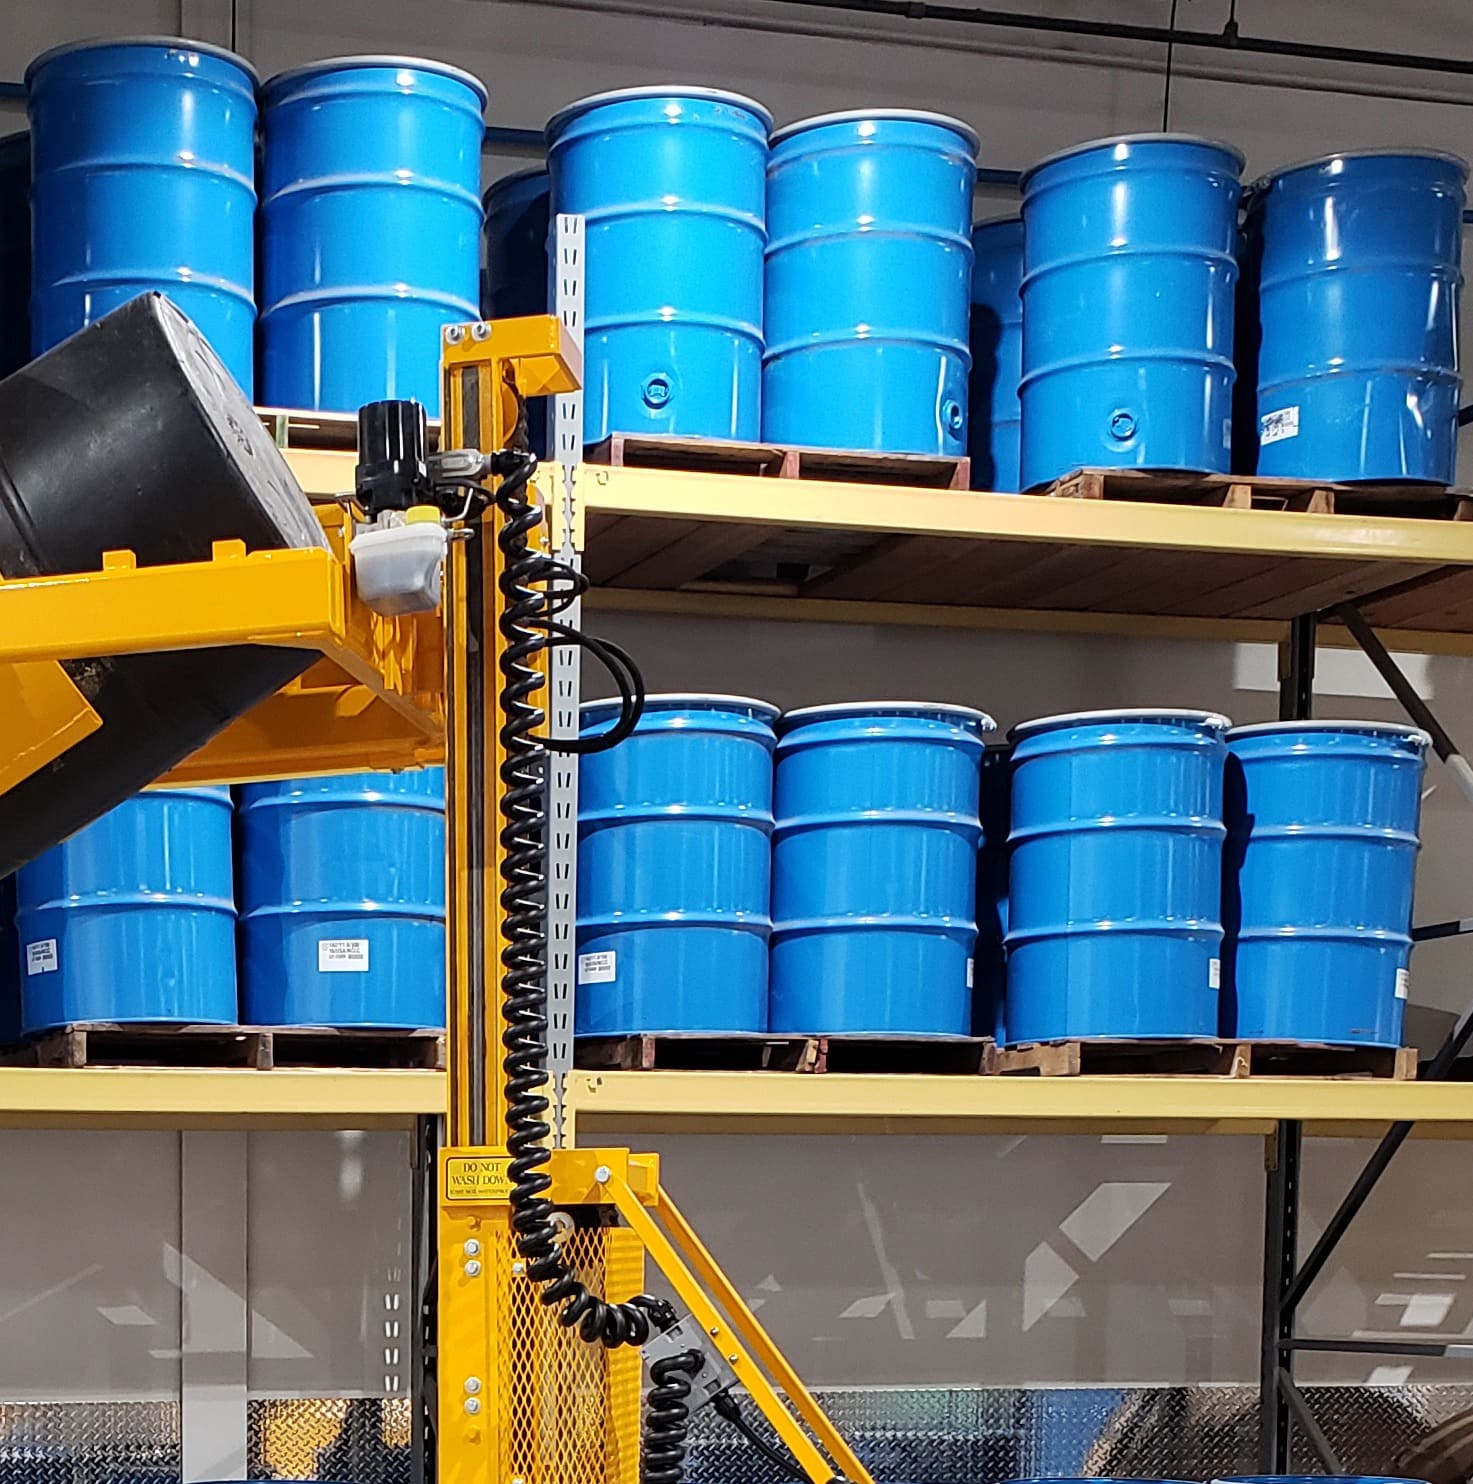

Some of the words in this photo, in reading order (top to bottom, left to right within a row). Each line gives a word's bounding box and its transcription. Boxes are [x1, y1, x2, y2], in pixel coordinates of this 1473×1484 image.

[463, 1162, 478, 1172] DO
[480, 1162, 501, 1172] NOT
[452, 1175, 480, 1185] WASH
[483, 1175, 509, 1185] DOW
